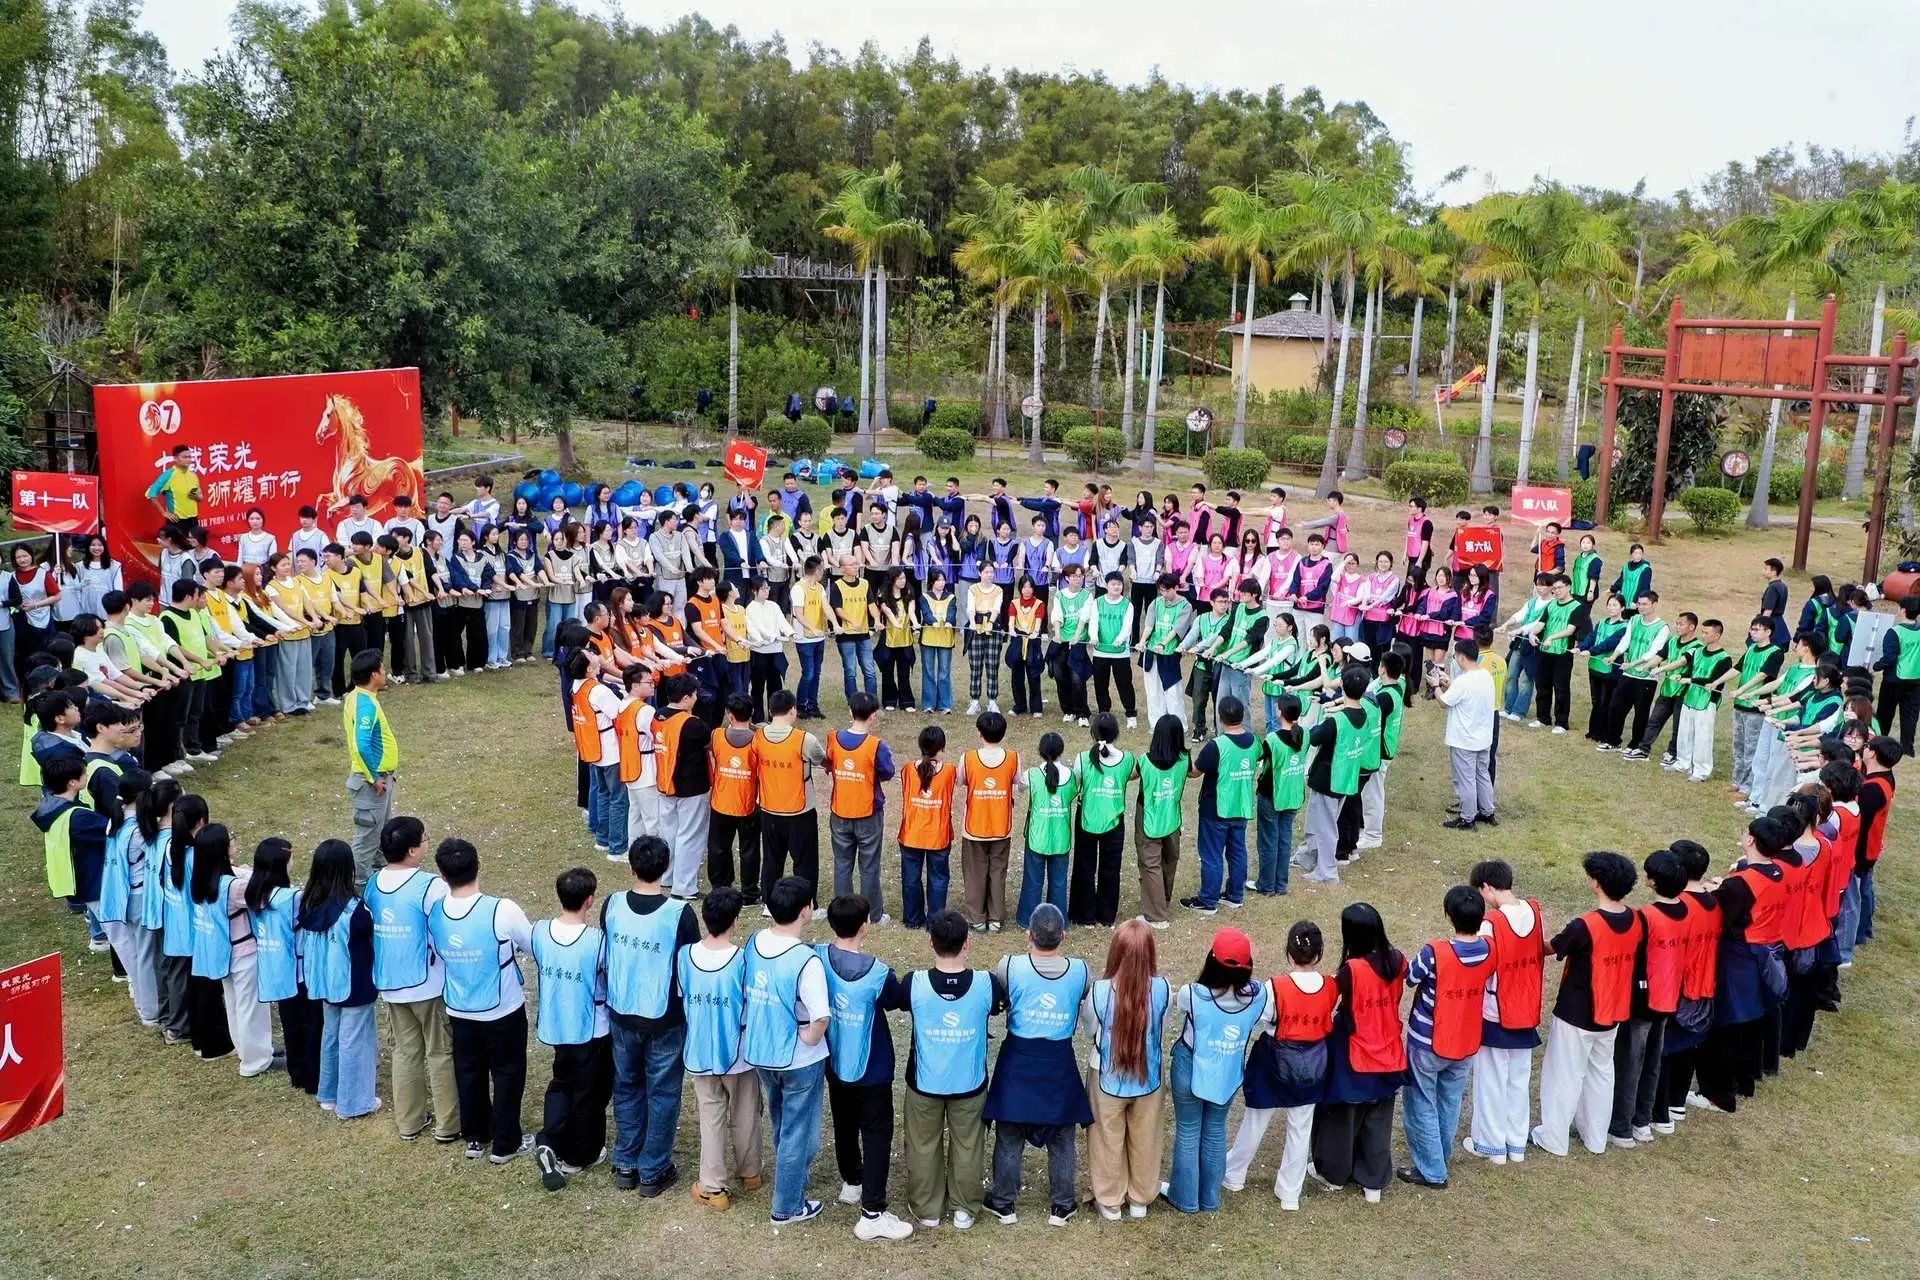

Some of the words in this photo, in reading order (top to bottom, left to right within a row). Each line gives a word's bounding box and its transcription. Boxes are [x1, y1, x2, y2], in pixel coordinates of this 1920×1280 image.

[734, 453, 757, 472] 第七队
[207, 470, 302, 508] 狮耀前行
[19, 489, 90, 511] 第十一队
[1522, 498, 1560, 512] 第八队
[1465, 541, 1493, 552] 第六队
